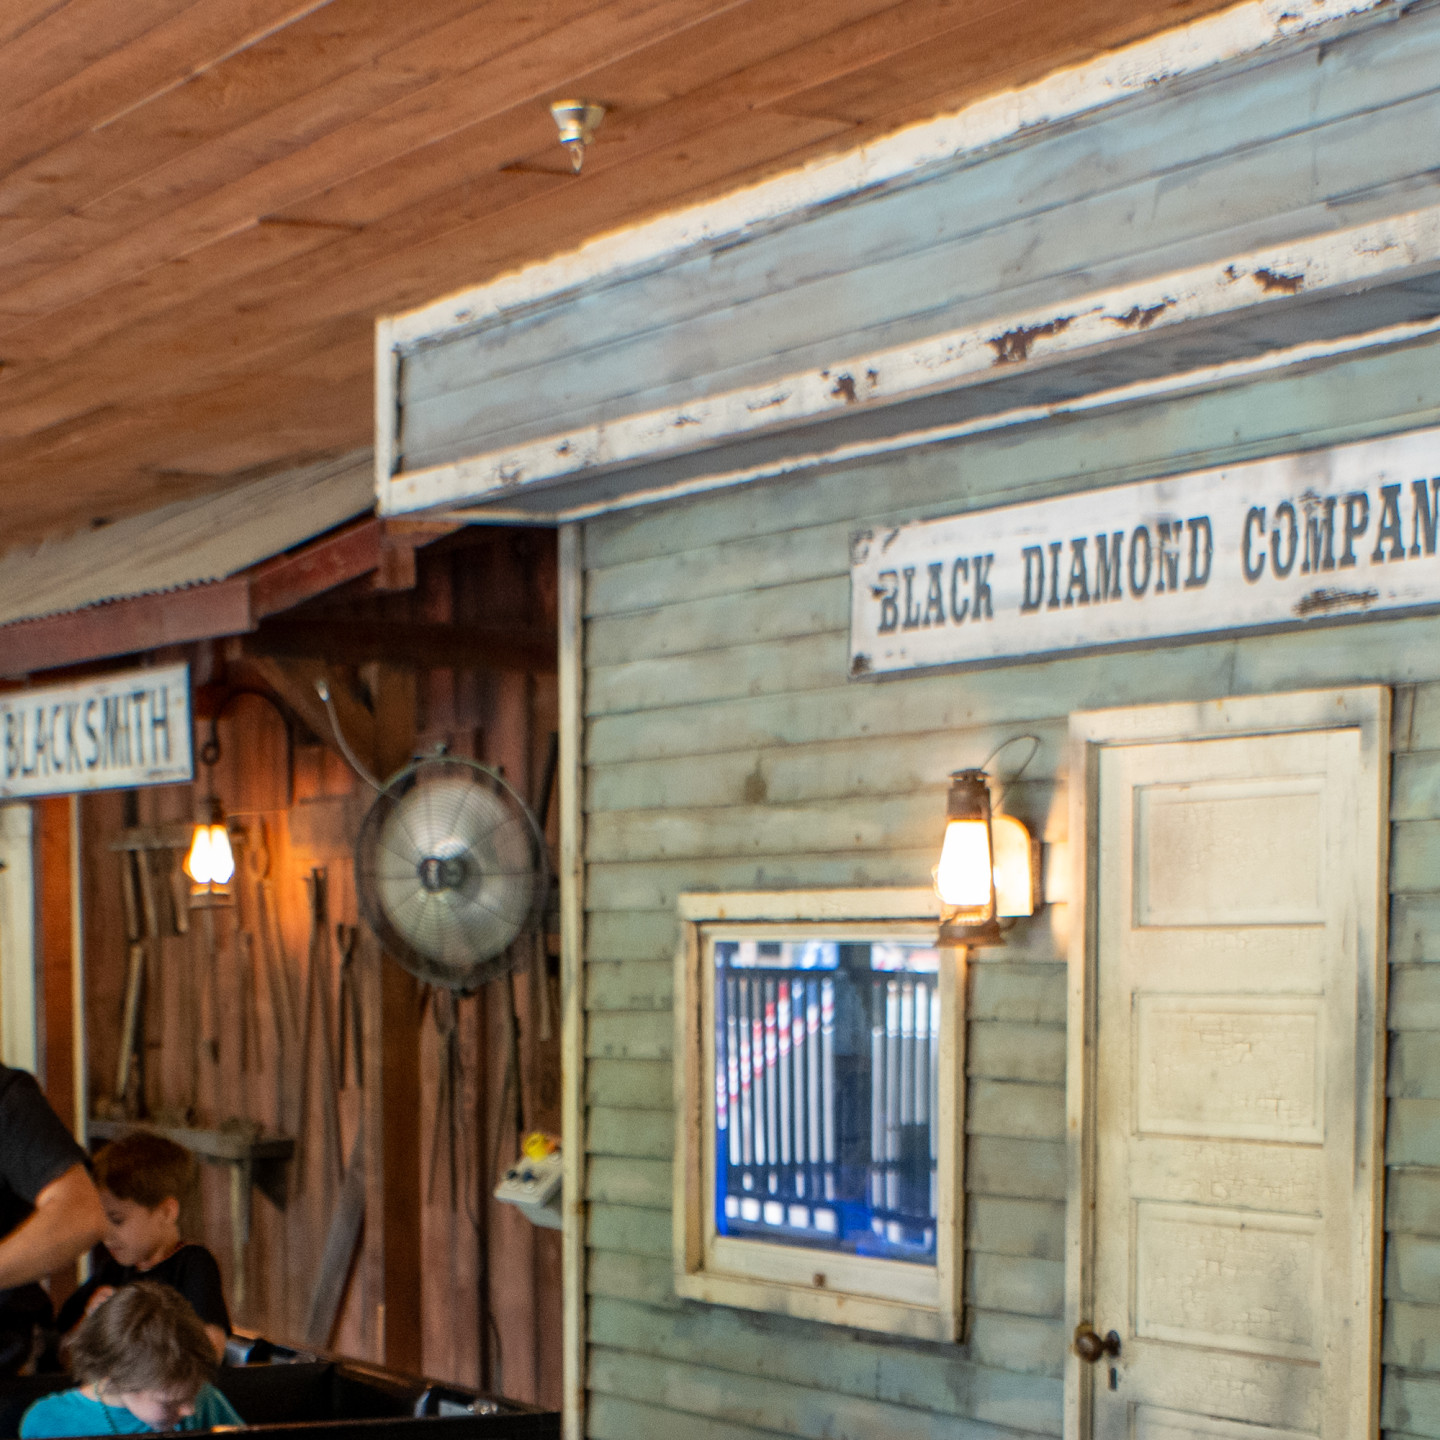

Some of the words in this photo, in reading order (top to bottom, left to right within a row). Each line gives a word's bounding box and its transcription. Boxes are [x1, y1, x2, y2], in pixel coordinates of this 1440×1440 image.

[877, 552, 995, 635] BLACK
[1019, 515, 1214, 616] DIAMOND
[5, 686, 171, 780] BLACKSMITH
